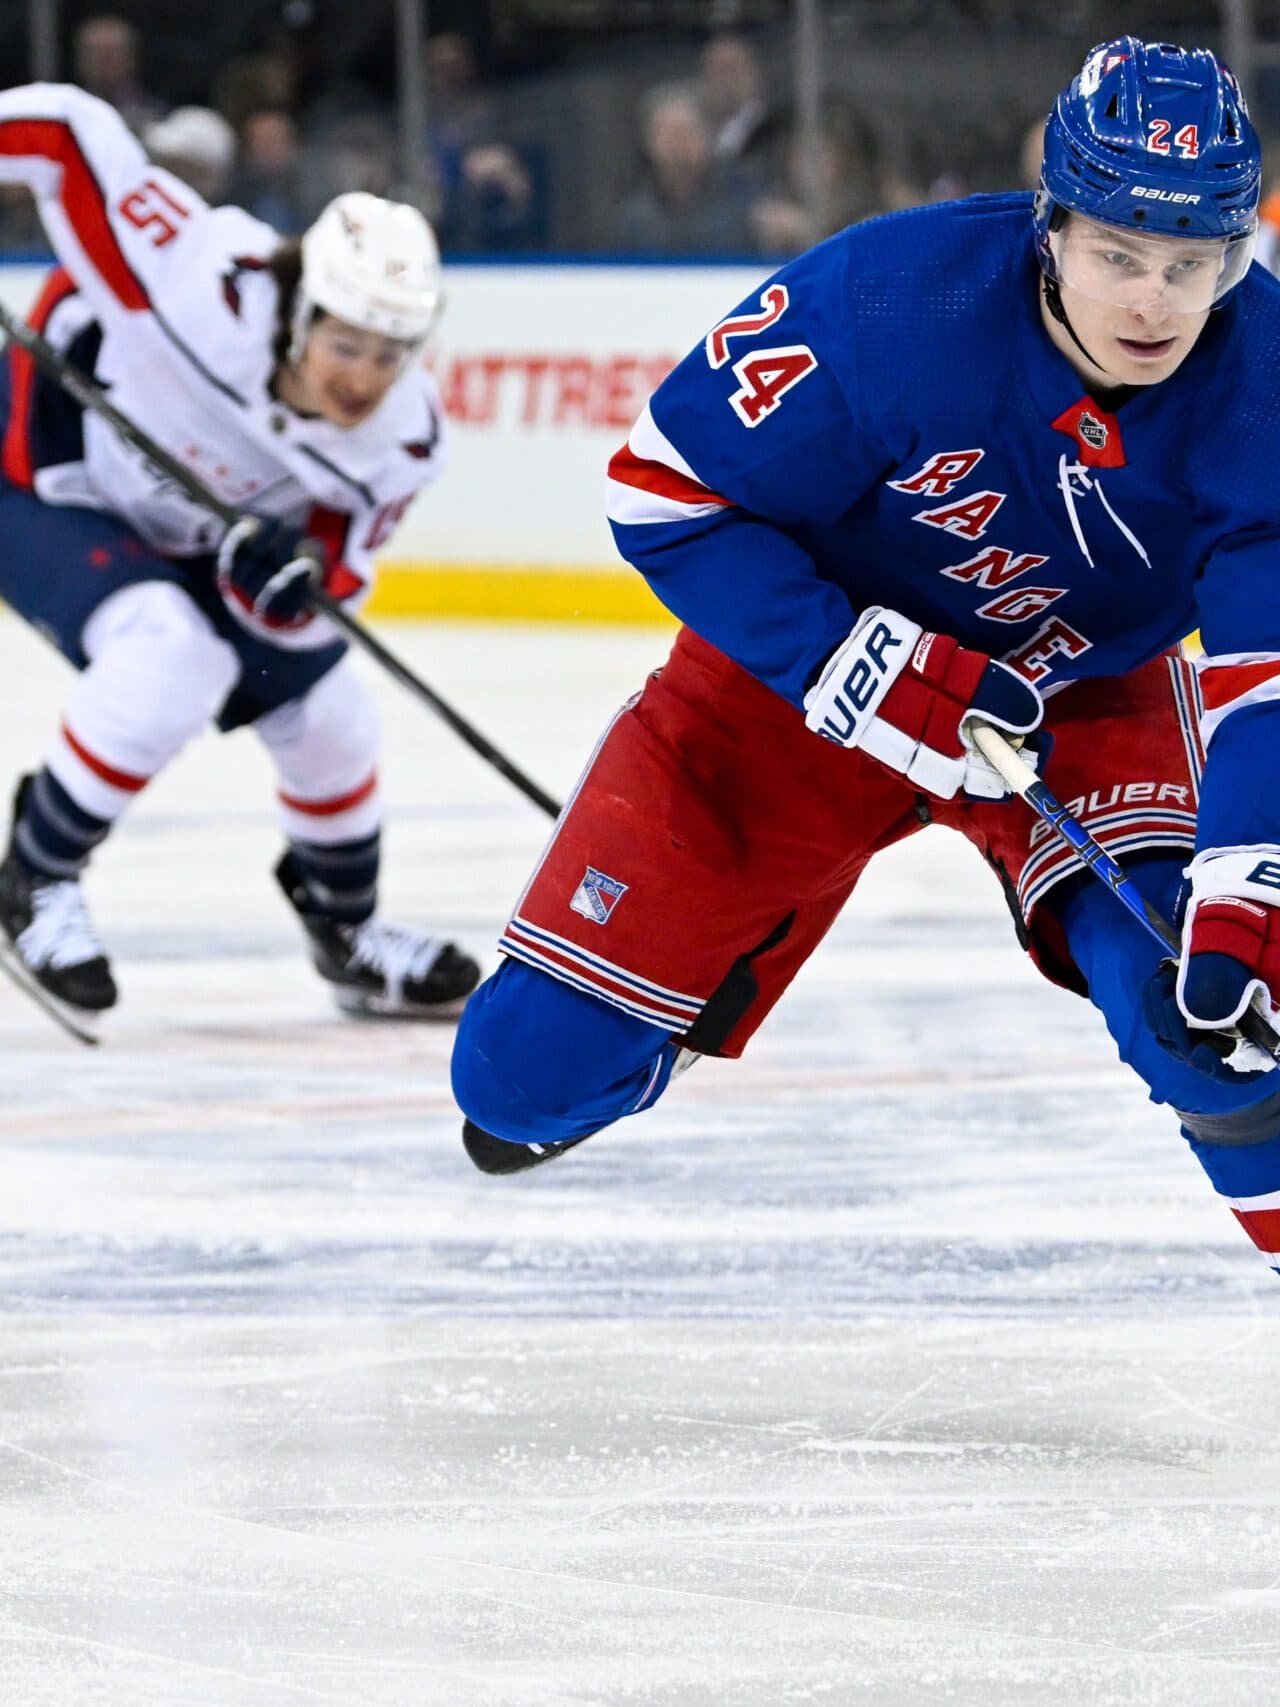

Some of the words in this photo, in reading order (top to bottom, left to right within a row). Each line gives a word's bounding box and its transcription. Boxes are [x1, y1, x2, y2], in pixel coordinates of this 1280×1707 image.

[1146, 118, 1199, 159] 24
[1130, 186, 1201, 206] BAUER
[424, 354, 684, 428] ATTRE
[706, 284, 818, 428] 24
[817, 622, 903, 747] UER
